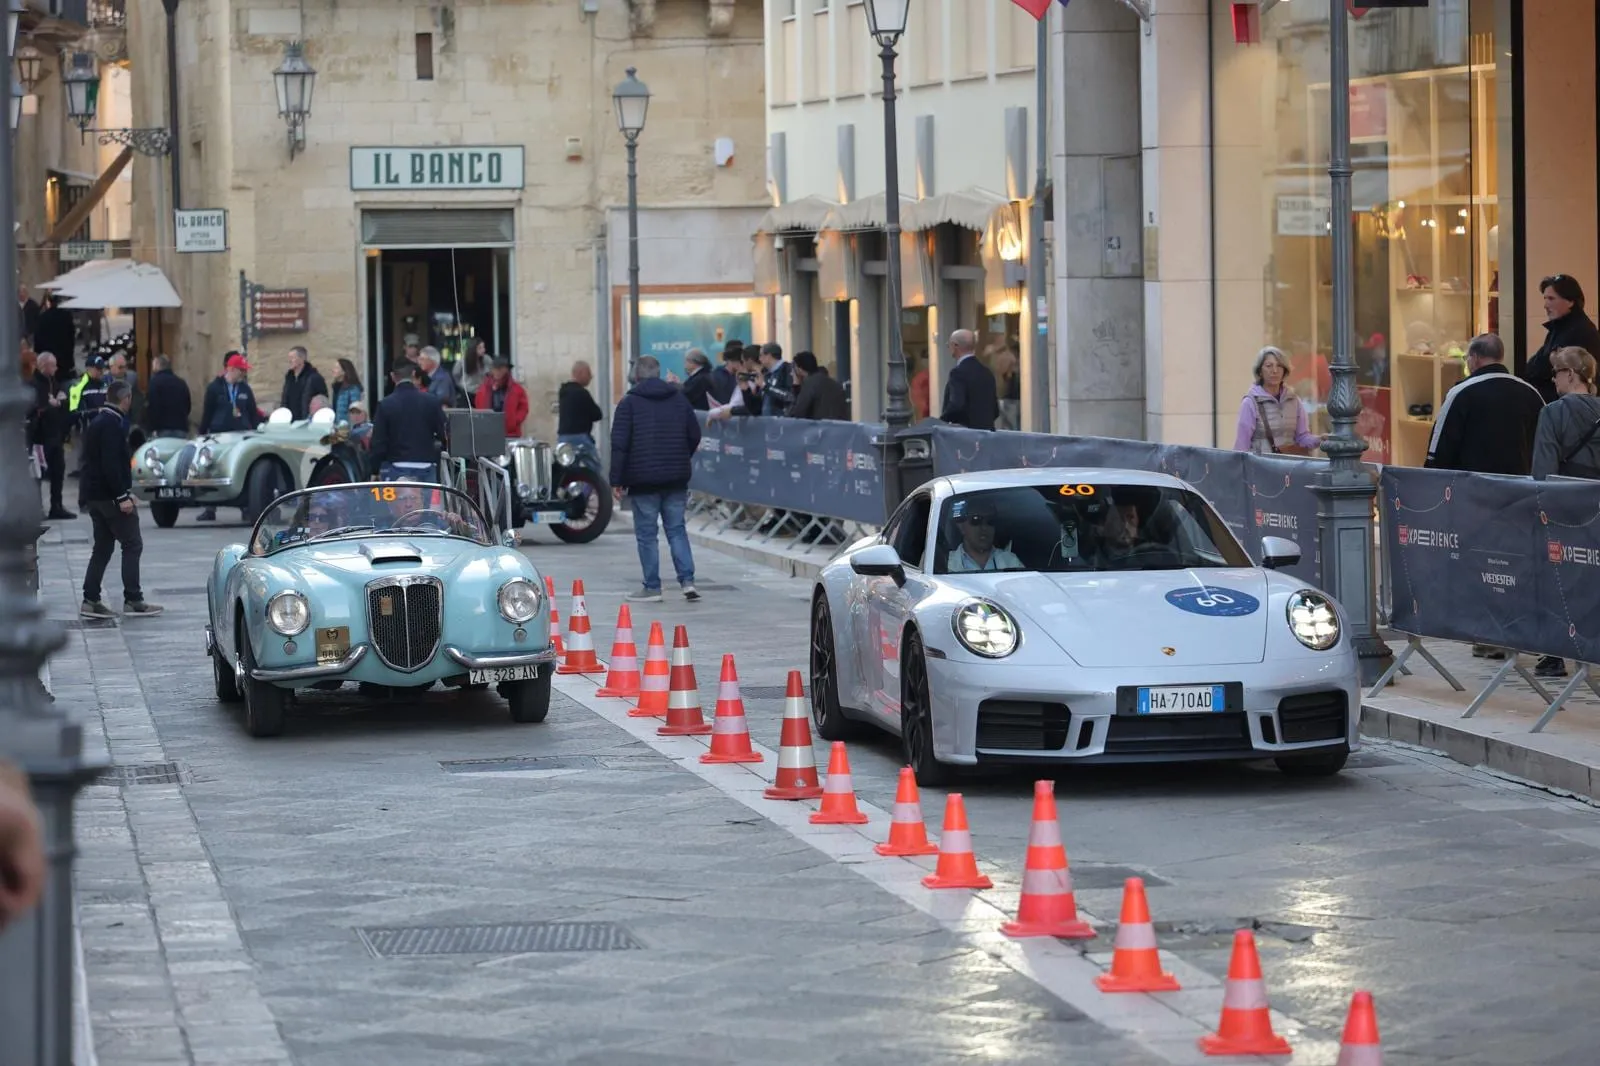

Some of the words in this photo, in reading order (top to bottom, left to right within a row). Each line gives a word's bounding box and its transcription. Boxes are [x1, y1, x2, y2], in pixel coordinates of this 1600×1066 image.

[374, 153, 399, 184] IL
[410, 153, 502, 184] BANCO
[177, 215, 188, 228] IL
[371, 486, 397, 501] 18
[1059, 484, 1095, 496] 60
[1408, 528, 1460, 549] XPERIENCE
[1196, 593, 1235, 607] 60
[472, 670, 487, 684] ZA
[494, 668, 516, 682] 328
[522, 664, 537, 679] AN
